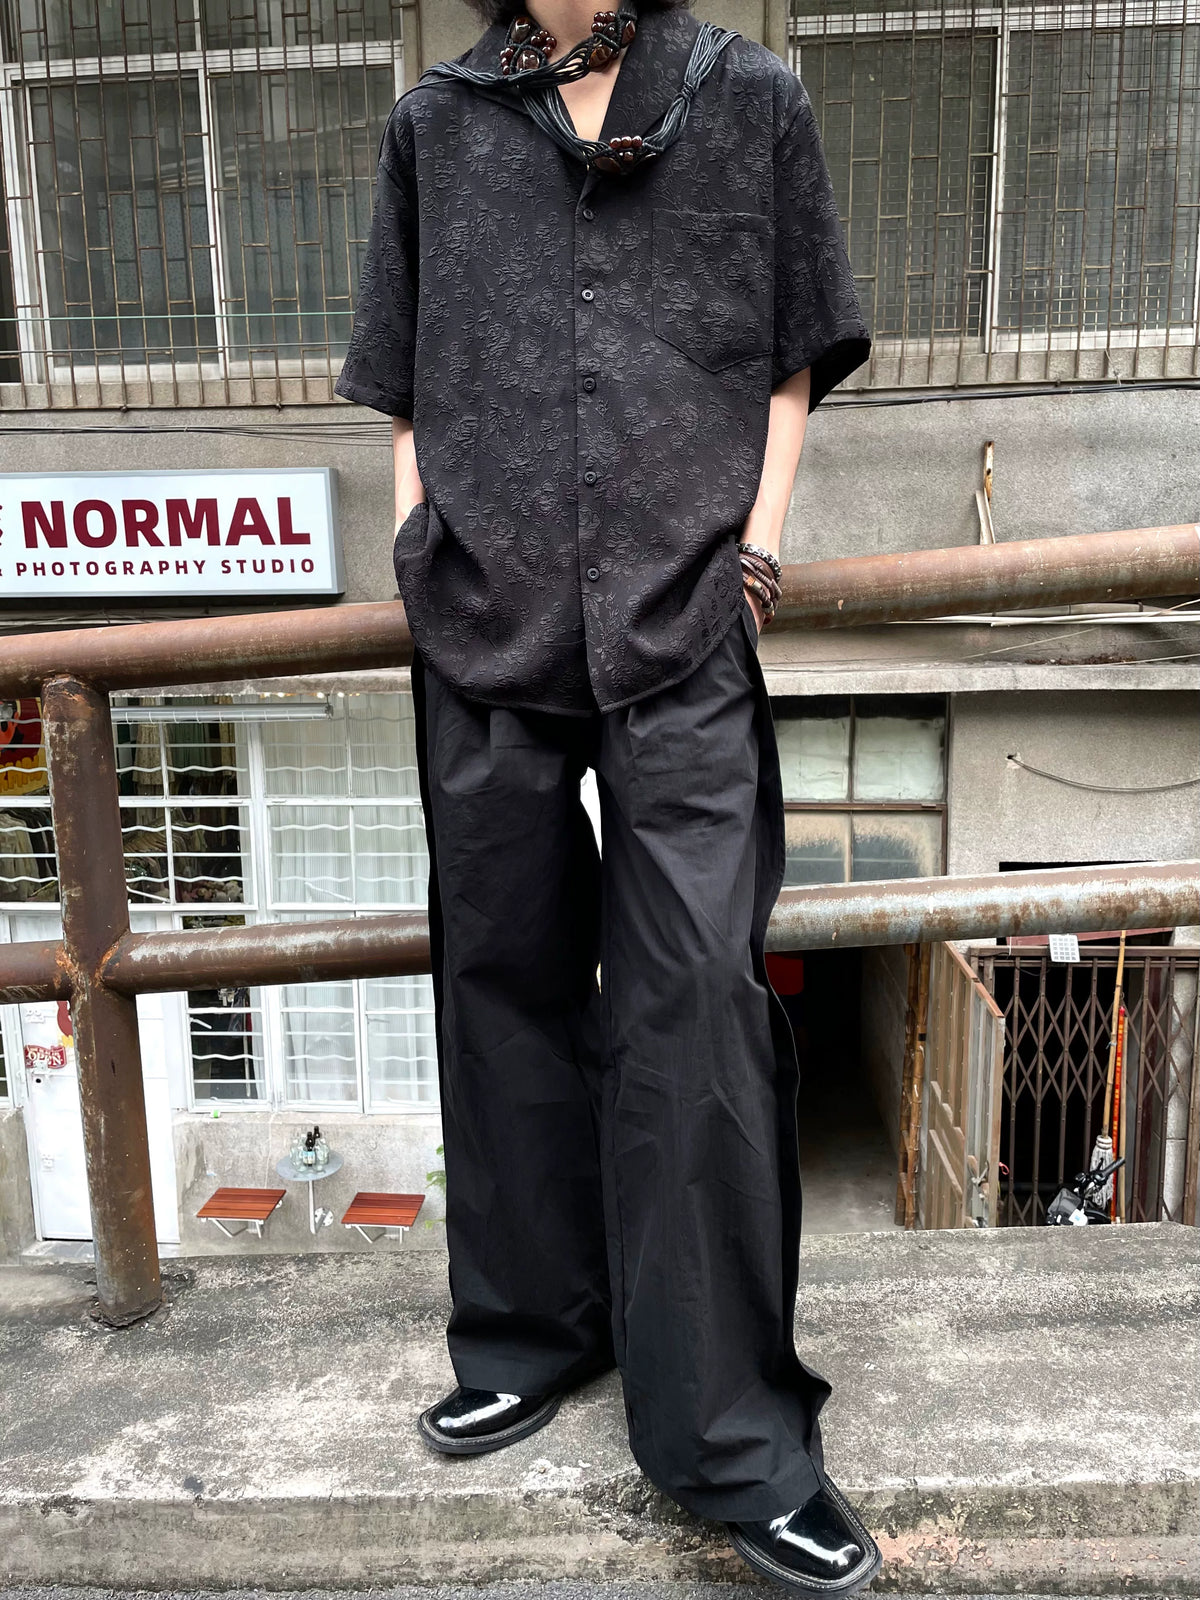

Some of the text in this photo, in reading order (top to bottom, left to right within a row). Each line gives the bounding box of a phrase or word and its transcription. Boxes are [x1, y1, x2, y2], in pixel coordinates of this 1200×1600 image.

[20, 497, 311, 549] NORMAL
[16, 559, 206, 577] PHOTOGRAPHY
[221, 558, 315, 575] STUDIO
